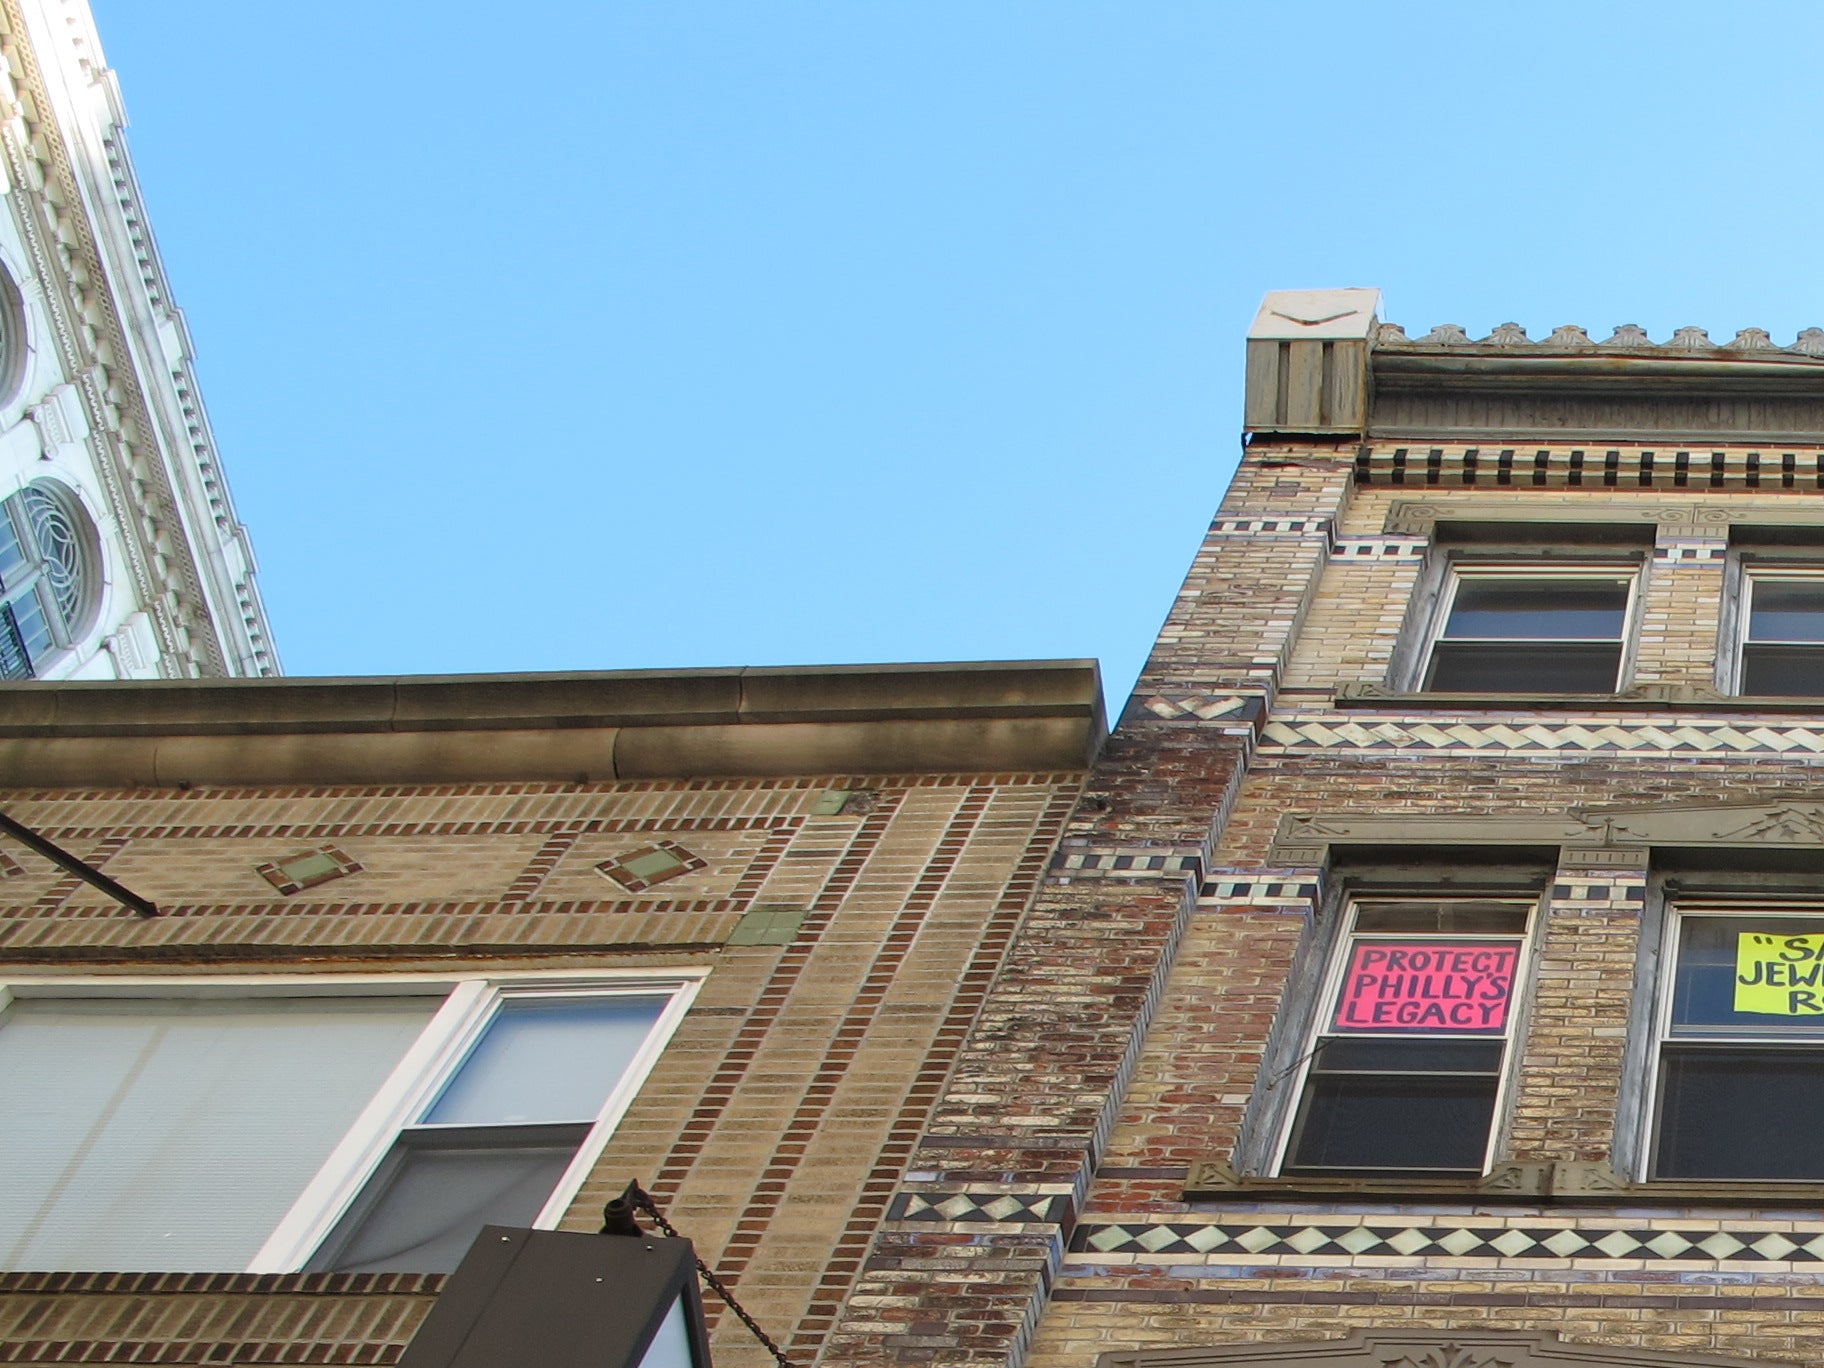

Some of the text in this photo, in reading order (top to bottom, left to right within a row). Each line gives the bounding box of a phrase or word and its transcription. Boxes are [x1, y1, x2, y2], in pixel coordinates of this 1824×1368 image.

[1360, 950, 1515, 973] PROTECT
[1353, 973, 1508, 1000] PHILLY'S
[1345, 1001, 1502, 1025] LEGACY
